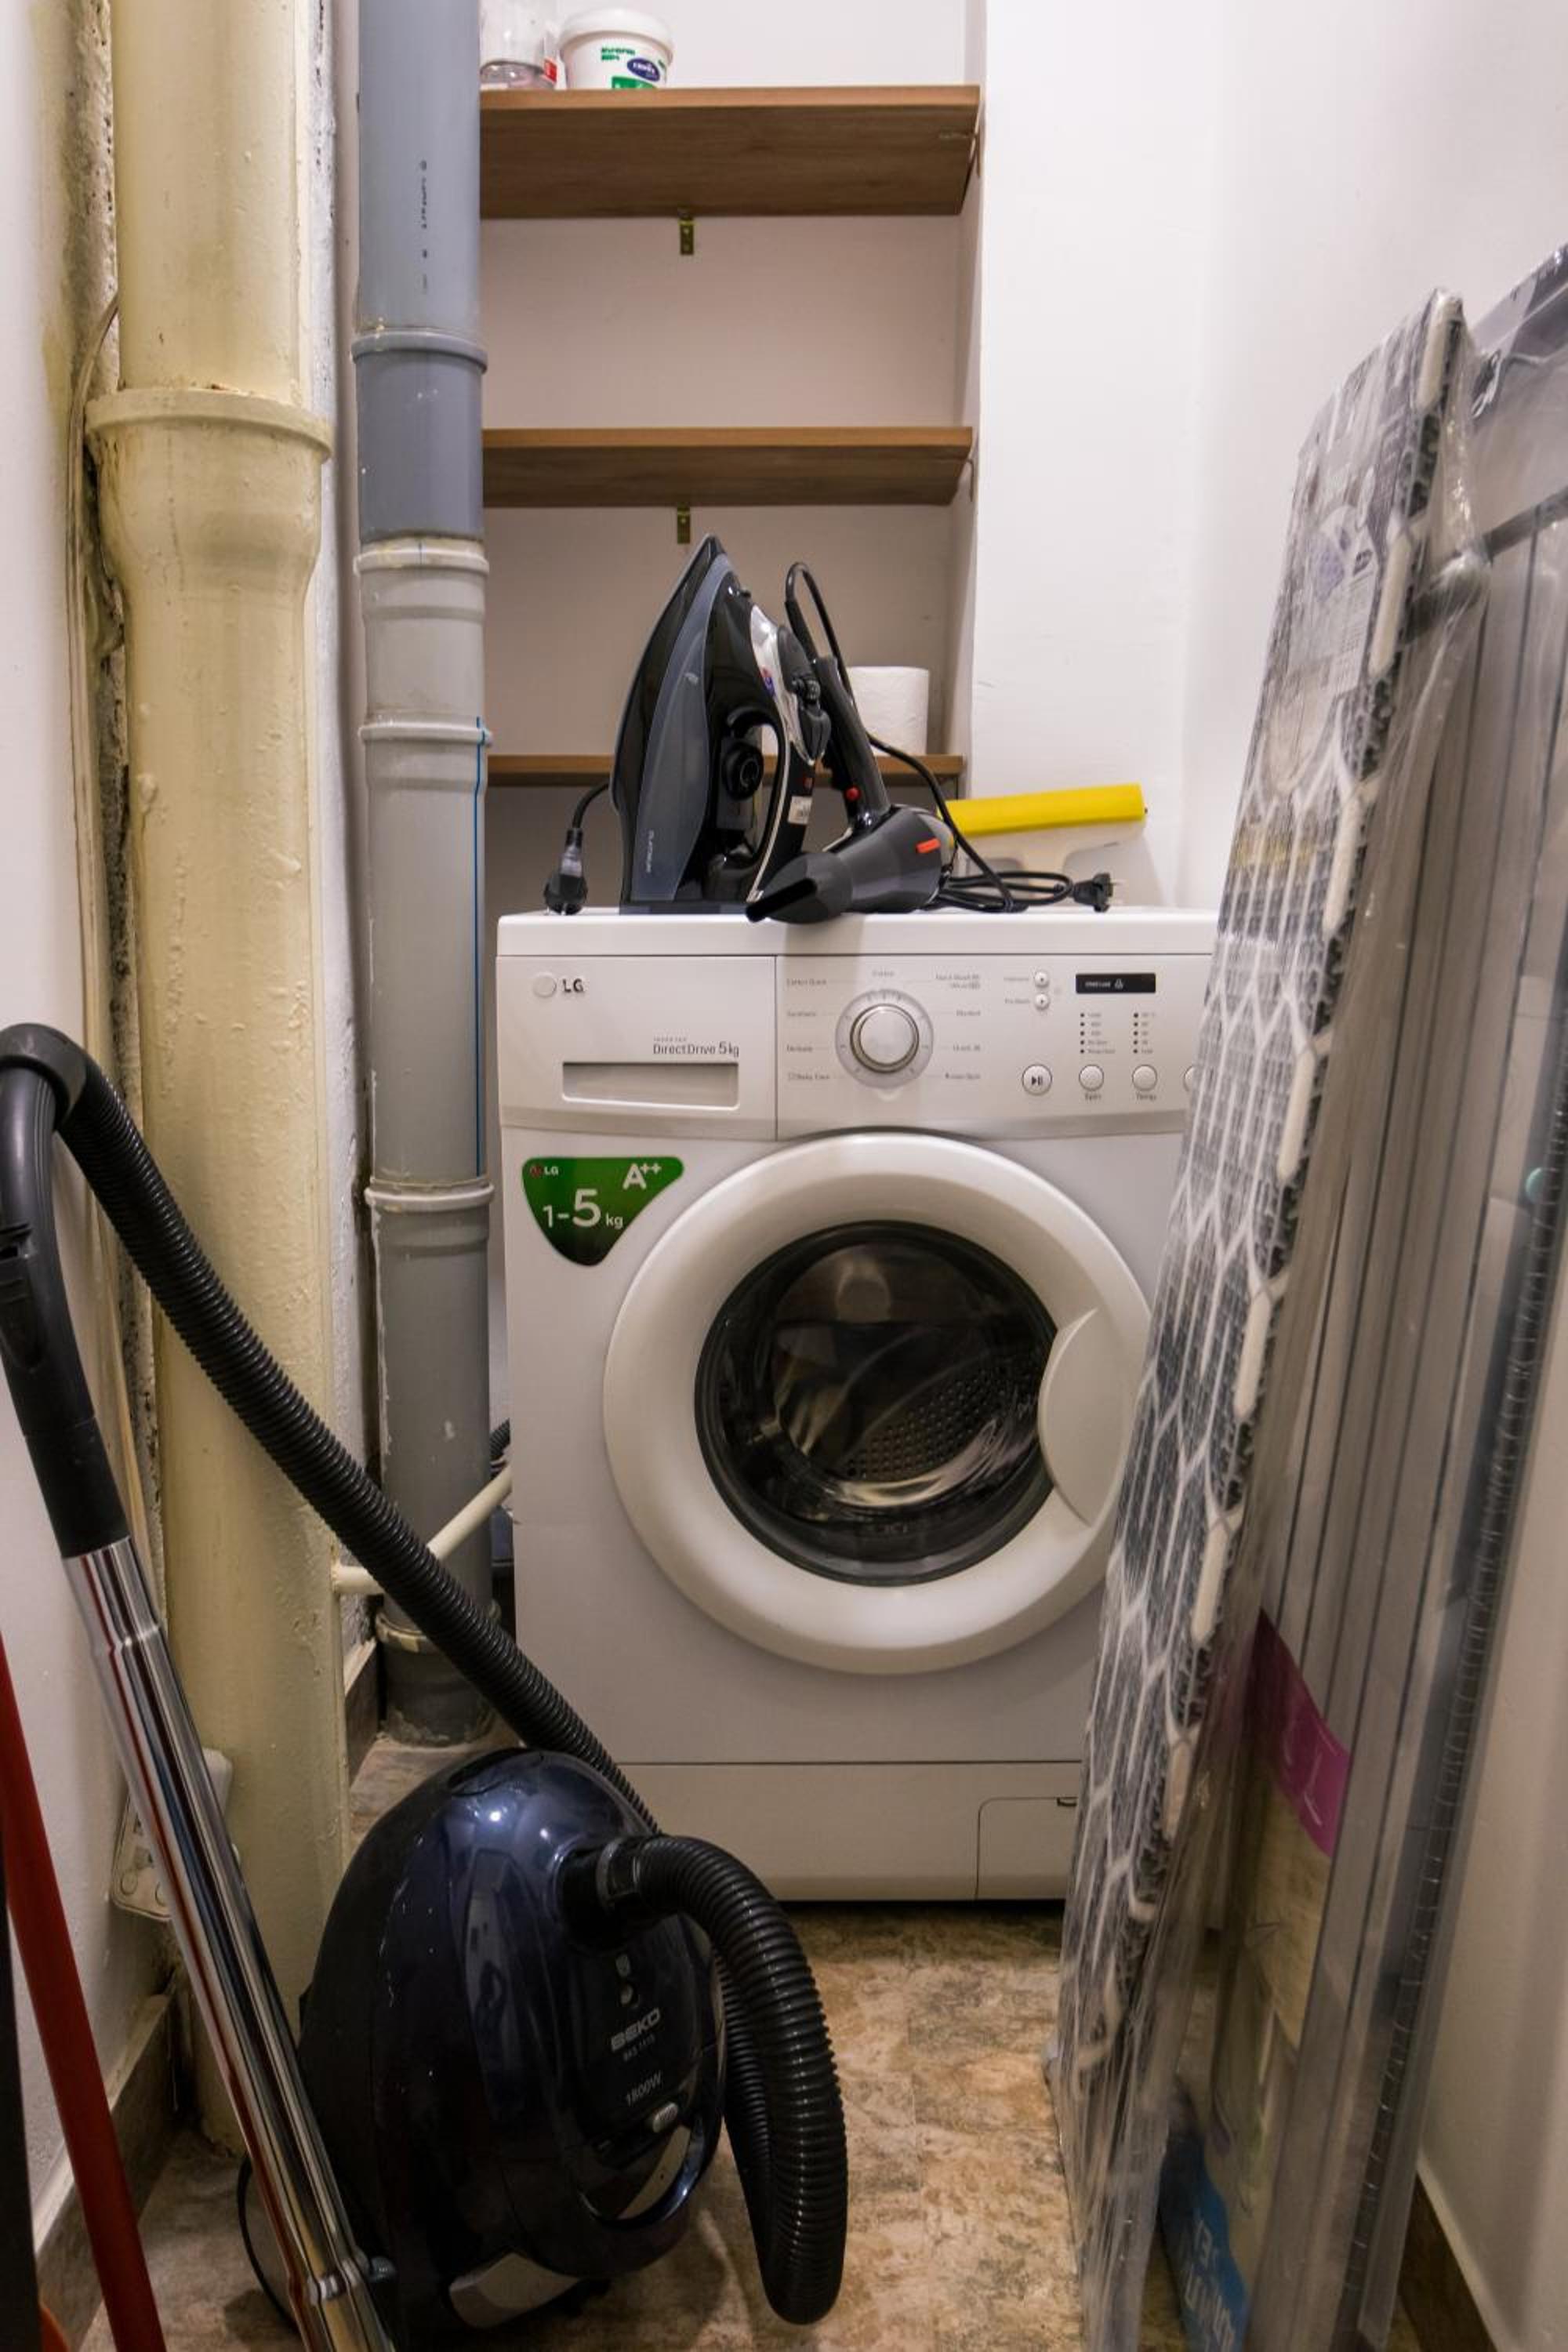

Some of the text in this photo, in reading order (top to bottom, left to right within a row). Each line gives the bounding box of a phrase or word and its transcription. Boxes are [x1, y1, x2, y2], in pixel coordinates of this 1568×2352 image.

[562, 978, 585, 993] LG
[543, 1166, 559, 1176] LG
[622, 1163, 662, 1189] A++
[605, 1213, 623, 1229] kg
[610, 2007, 661, 2053] BEKO
